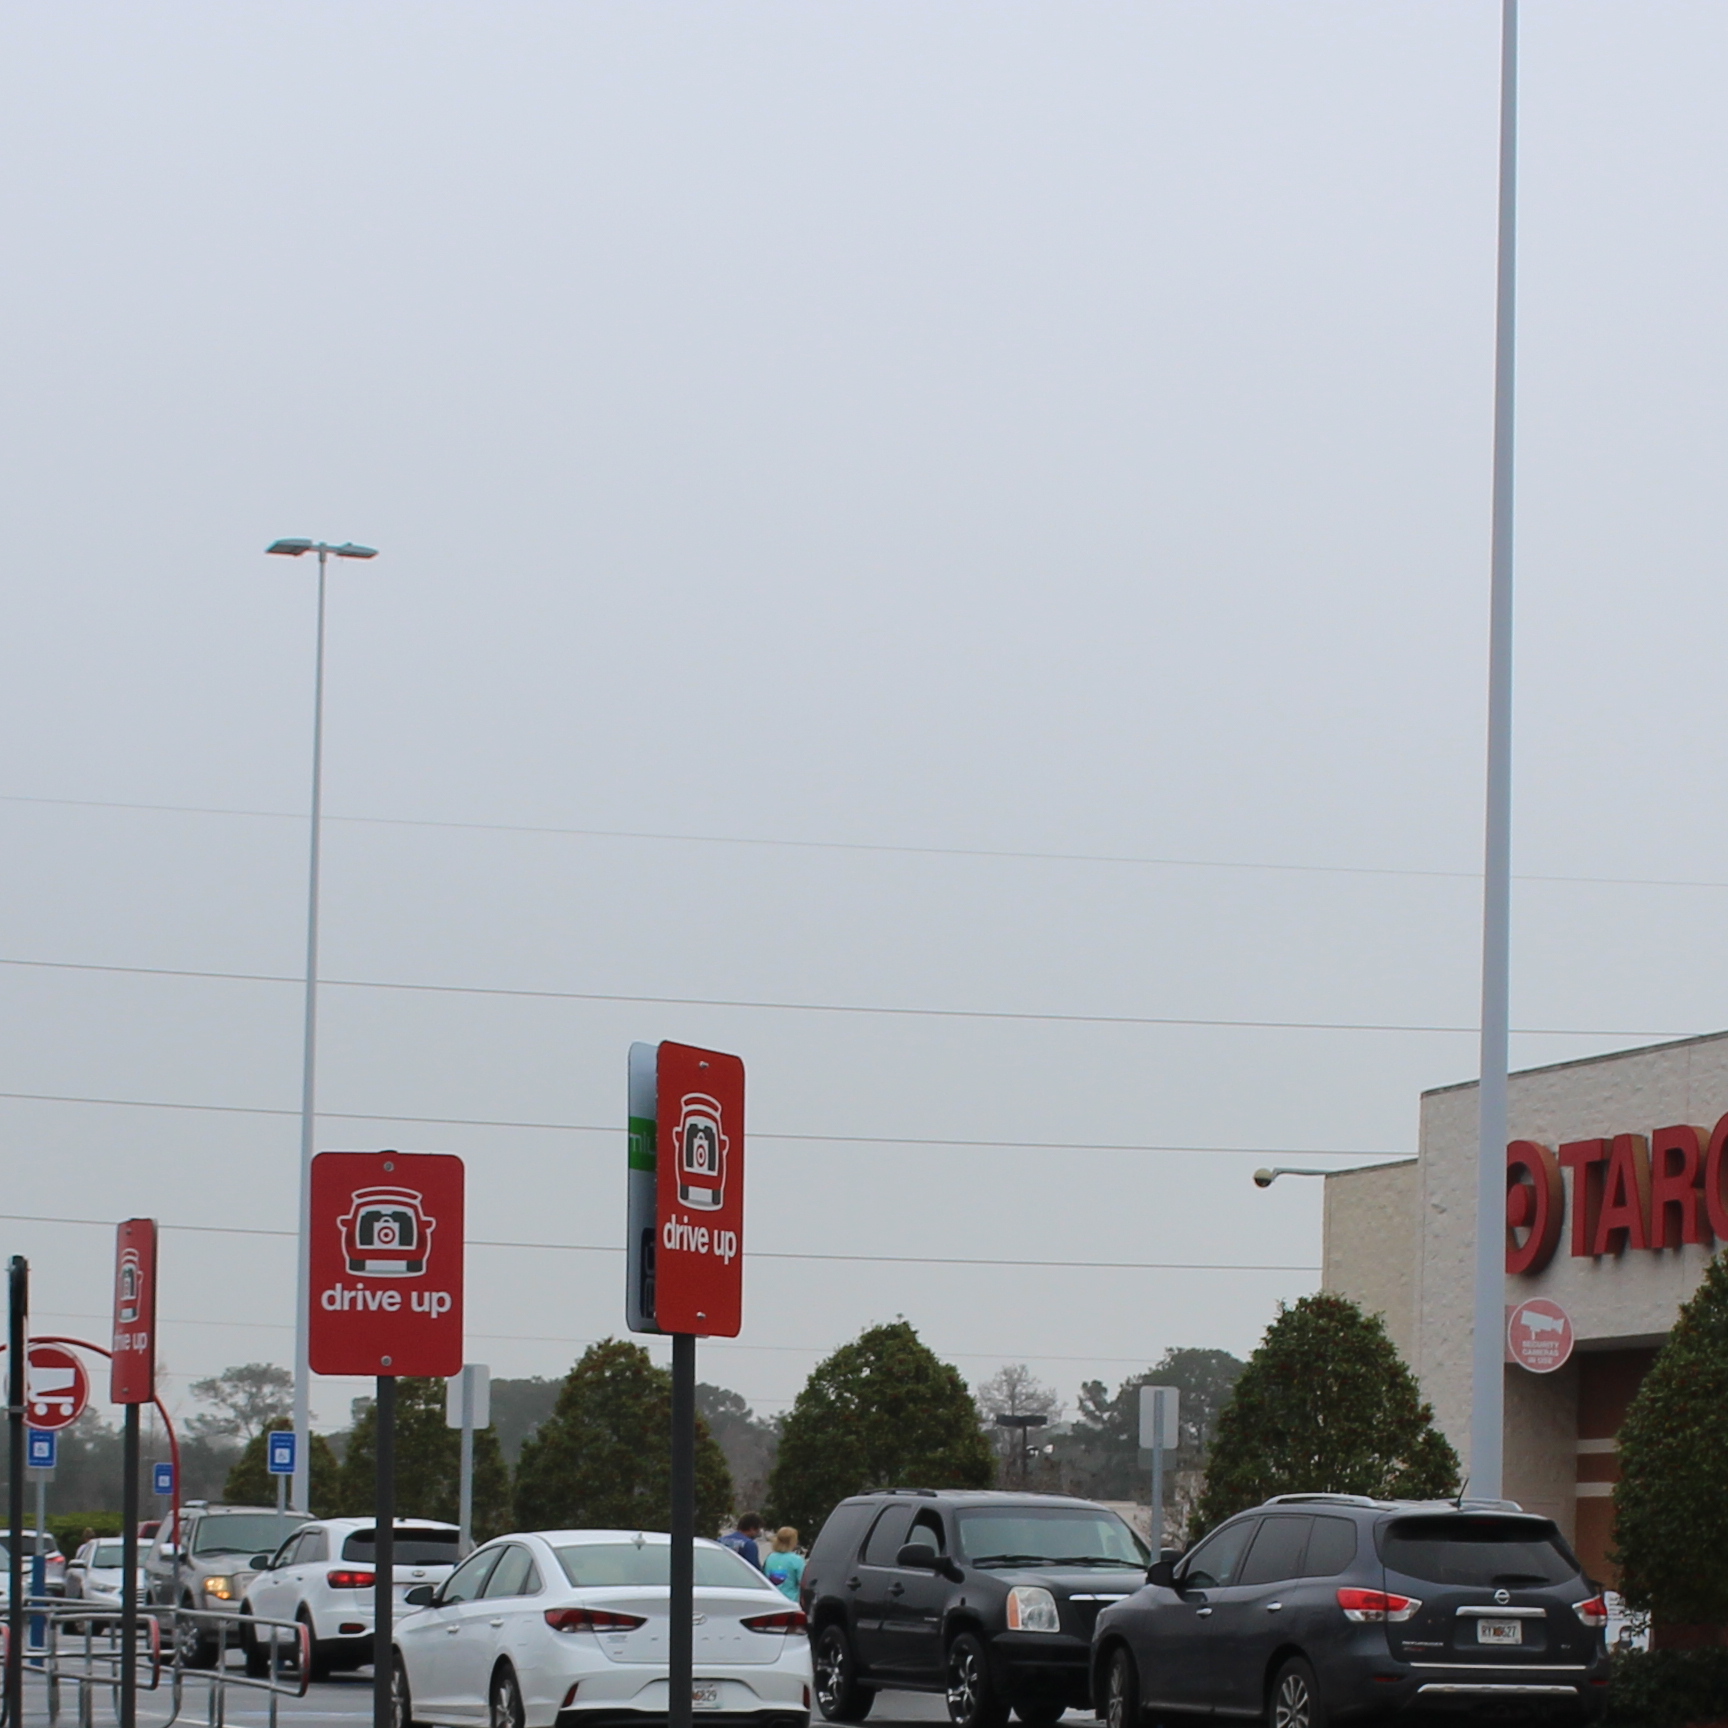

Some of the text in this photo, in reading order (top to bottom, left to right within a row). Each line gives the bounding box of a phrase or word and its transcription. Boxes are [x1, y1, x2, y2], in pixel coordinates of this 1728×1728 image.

[663, 1213, 738, 1266] drive up
[321, 1283, 452, 1319] drive up
[133, 1332, 148, 1354] up
